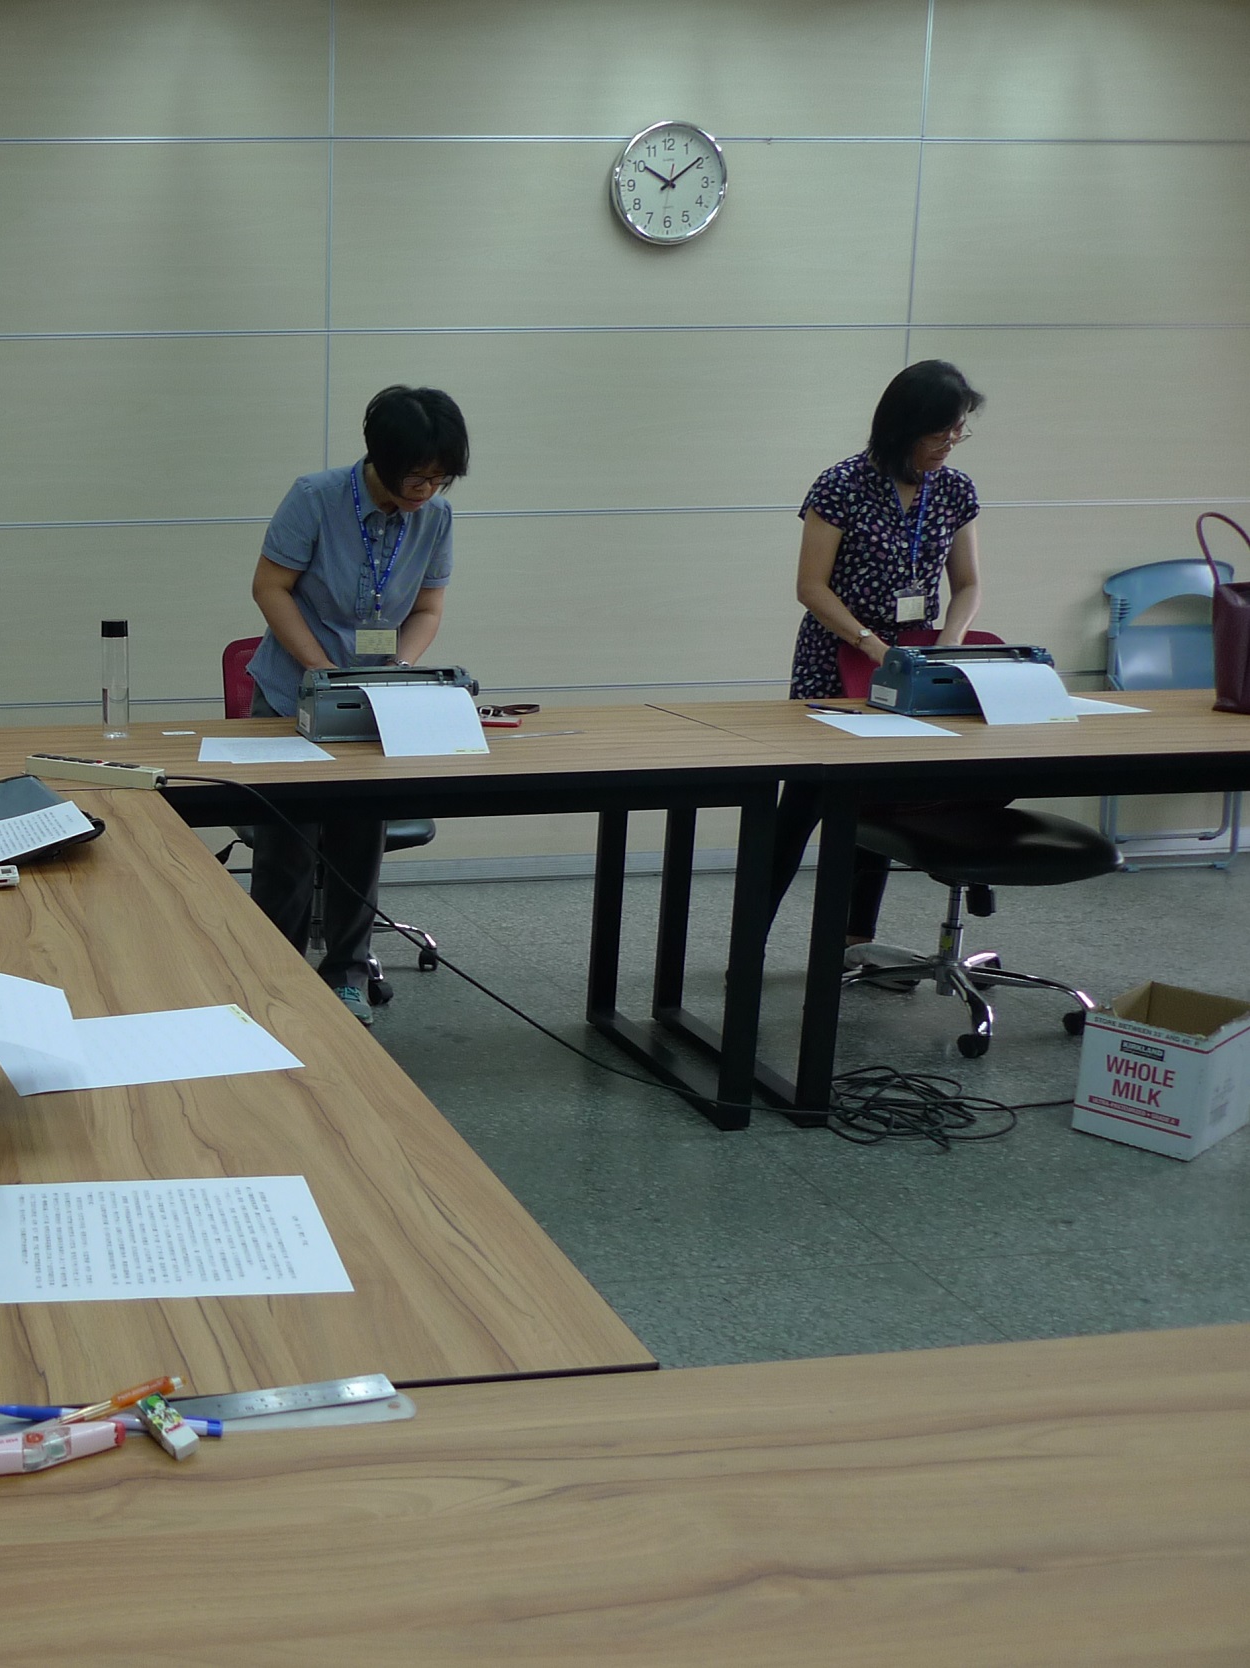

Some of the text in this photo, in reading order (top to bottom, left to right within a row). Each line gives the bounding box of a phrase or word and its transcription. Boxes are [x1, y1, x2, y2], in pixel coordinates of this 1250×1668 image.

[646, 145, 657, 157] 11
[662, 138, 675, 151] 12
[683, 144, 689, 155] 1
[632, 160, 646, 173] 10
[696, 157, 704, 169] 2
[627, 179, 636, 192] 9
[701, 176, 709, 189] 3
[633, 198, 641, 210] 8
[695, 195, 704, 207] 4
[645, 212, 654, 224] 7
[663, 215, 672, 228] 6
[681, 210, 690, 223] 5
[1094, 1016, 1116, 1027] STORE
[1118, 1022, 1152, 1035] BETWEEN
[1165, 1034, 1180, 1042] AND
[1107, 1054, 1176, 1088] WHOLE
[1112, 1079, 1162, 1108] MILK
